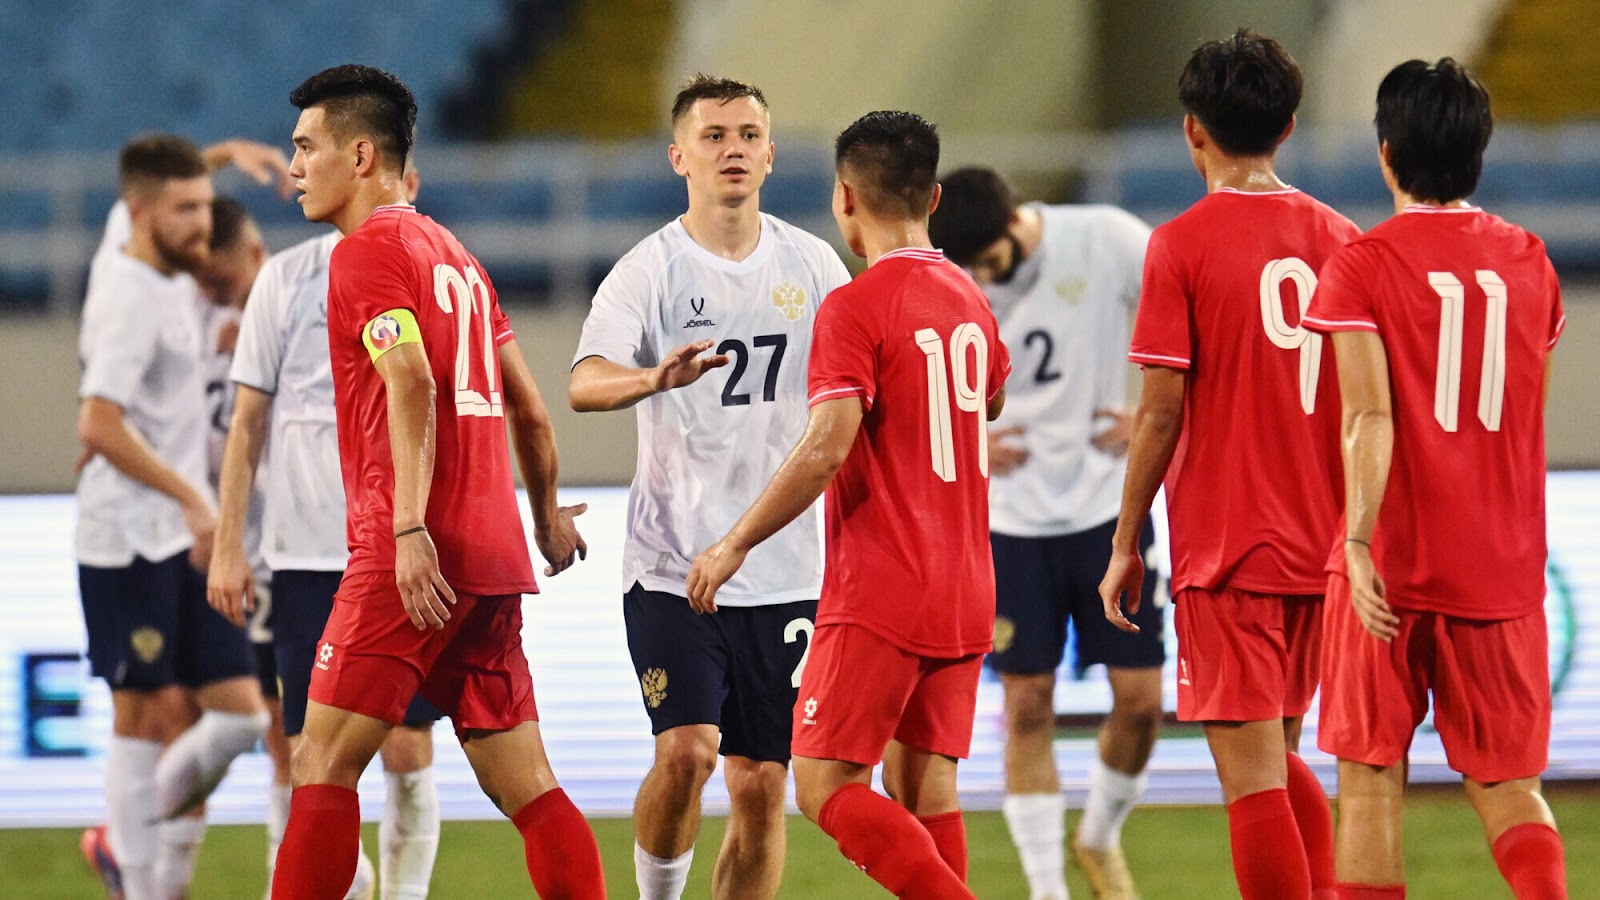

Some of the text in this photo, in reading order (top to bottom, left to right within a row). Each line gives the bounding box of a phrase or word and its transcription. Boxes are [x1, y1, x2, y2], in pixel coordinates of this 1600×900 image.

[433, 263, 504, 417] 22
[683, 319, 716, 328] JÖGEL
[715, 334, 788, 407] 27
[1023, 329, 1061, 384] 2
[1260, 257, 1322, 415] 9
[1428, 270, 1507, 433] 11
[915, 322, 989, 482] 19
[784, 617, 815, 689] 2
